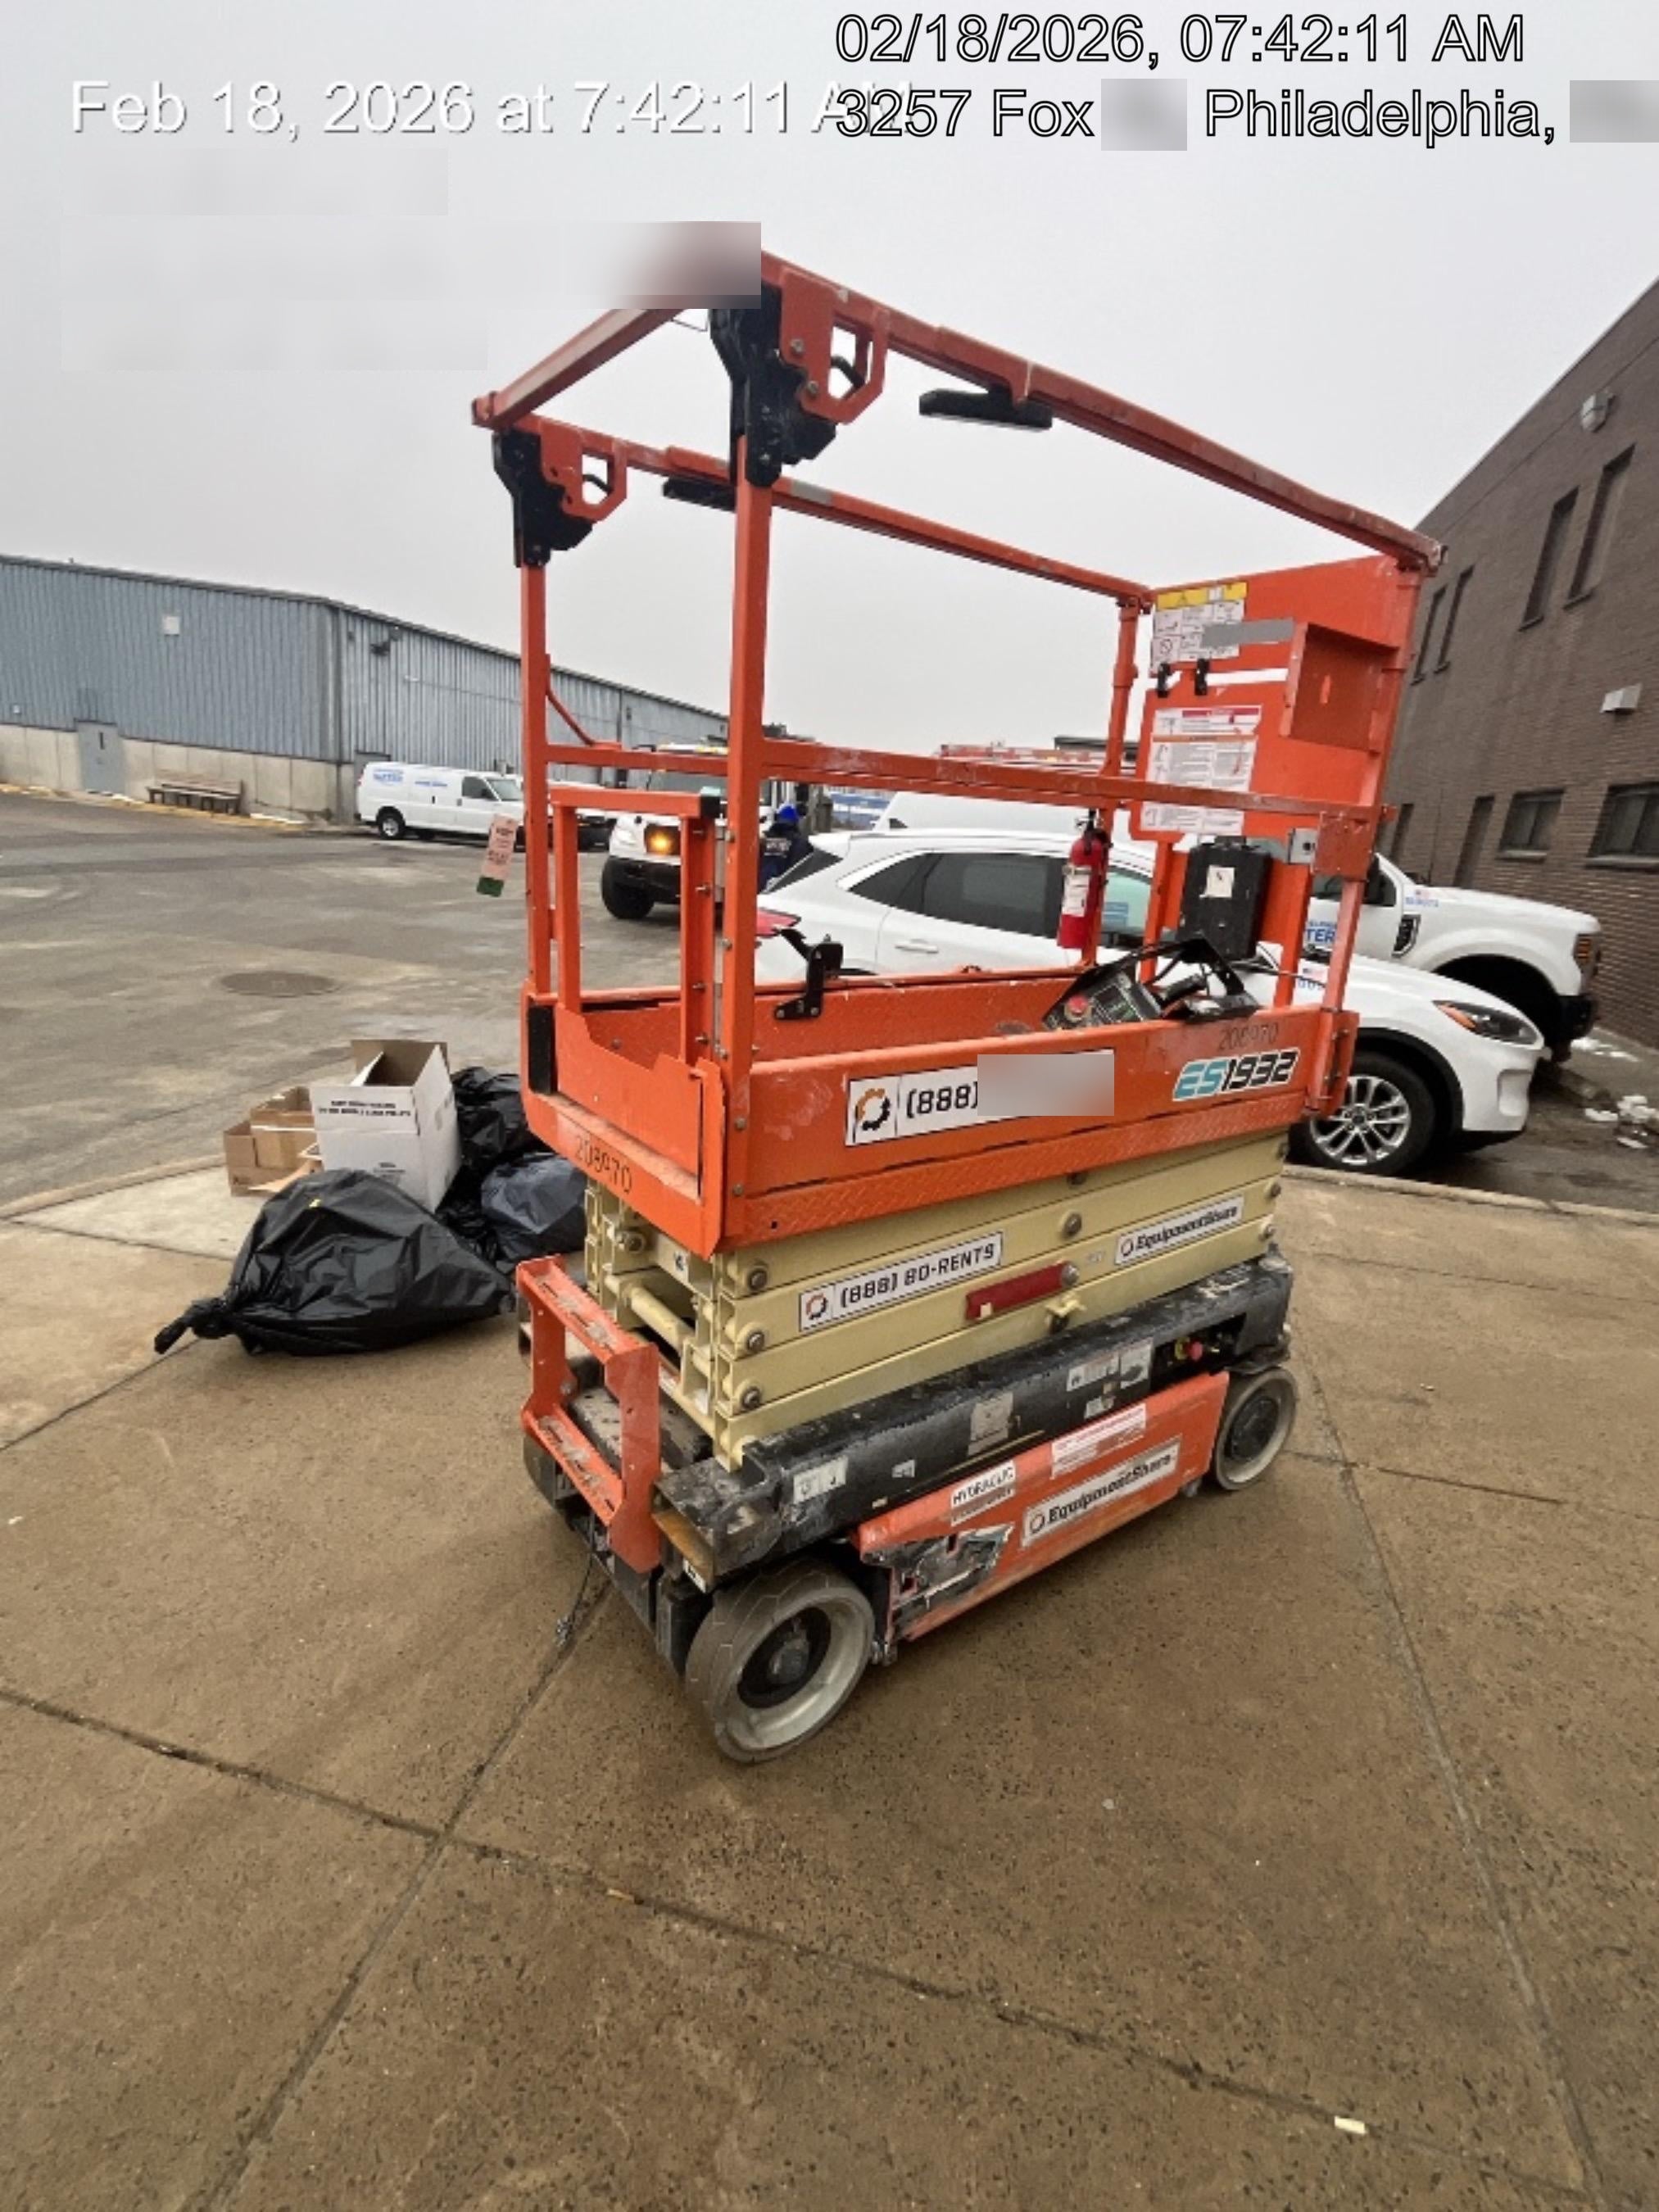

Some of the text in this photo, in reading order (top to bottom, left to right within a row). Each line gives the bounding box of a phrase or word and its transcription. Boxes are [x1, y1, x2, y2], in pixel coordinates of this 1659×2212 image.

[1172, 1049, 1299, 1100] ES1932
[906, 1081, 978, 1119] (888)
[841, 1272, 899, 1308] (888)
[1048, 1453, 1172, 1525] EquipmentShare
